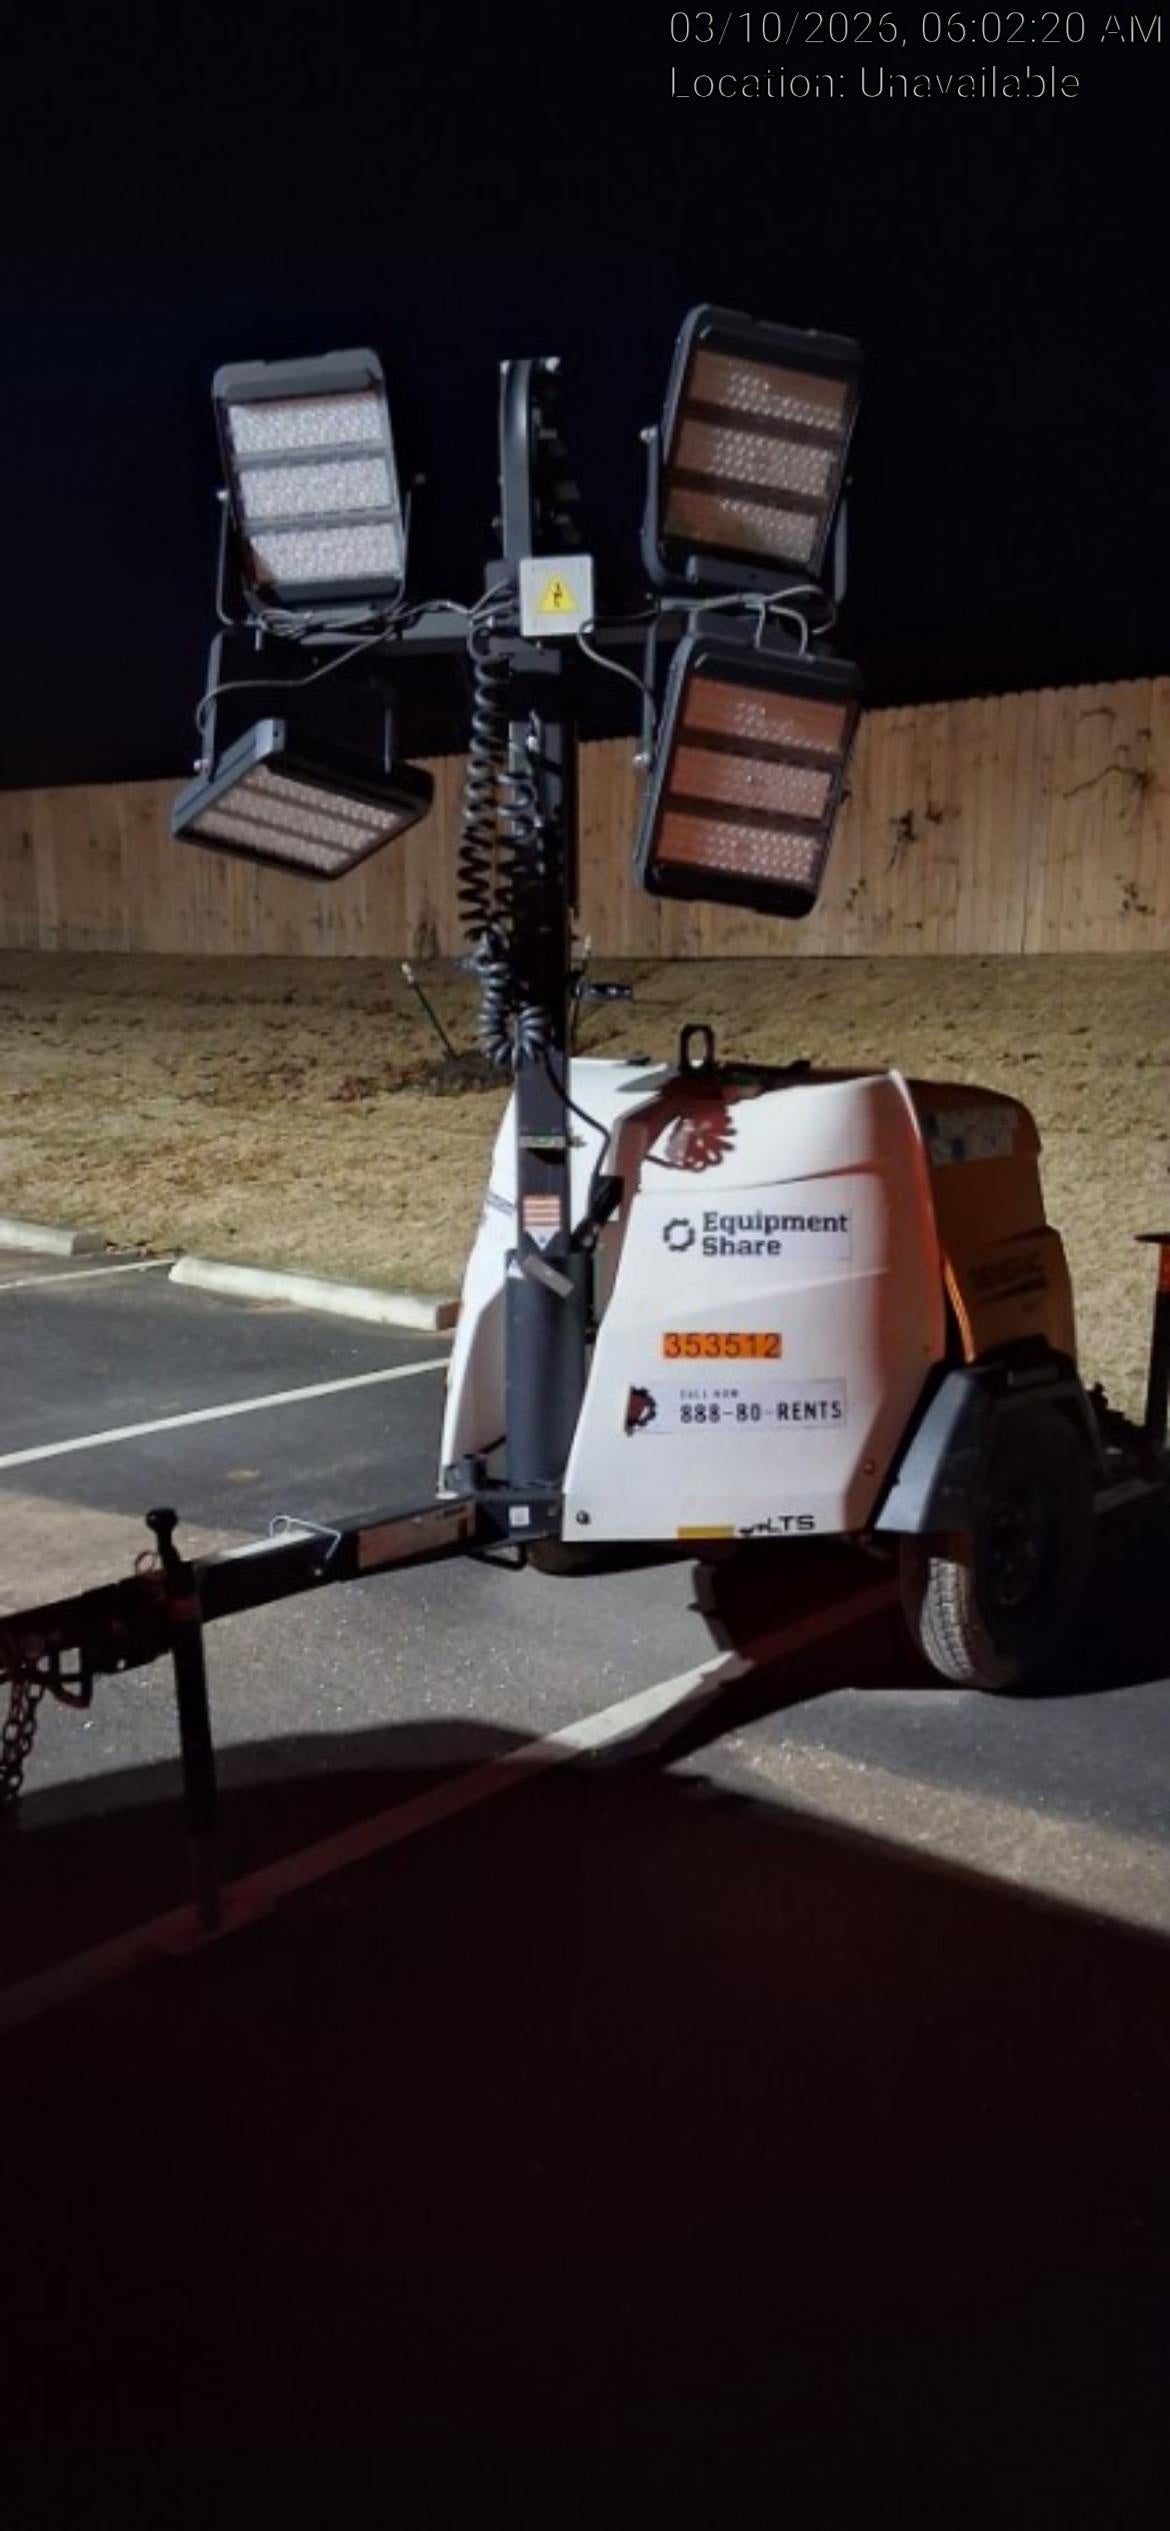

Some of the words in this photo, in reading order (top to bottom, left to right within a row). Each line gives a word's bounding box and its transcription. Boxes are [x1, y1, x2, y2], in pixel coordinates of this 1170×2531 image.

[703, 1211, 848, 1235] Equipment
[702, 1237, 782, 1256] Share
[664, 1333, 781, 1358] 353512
